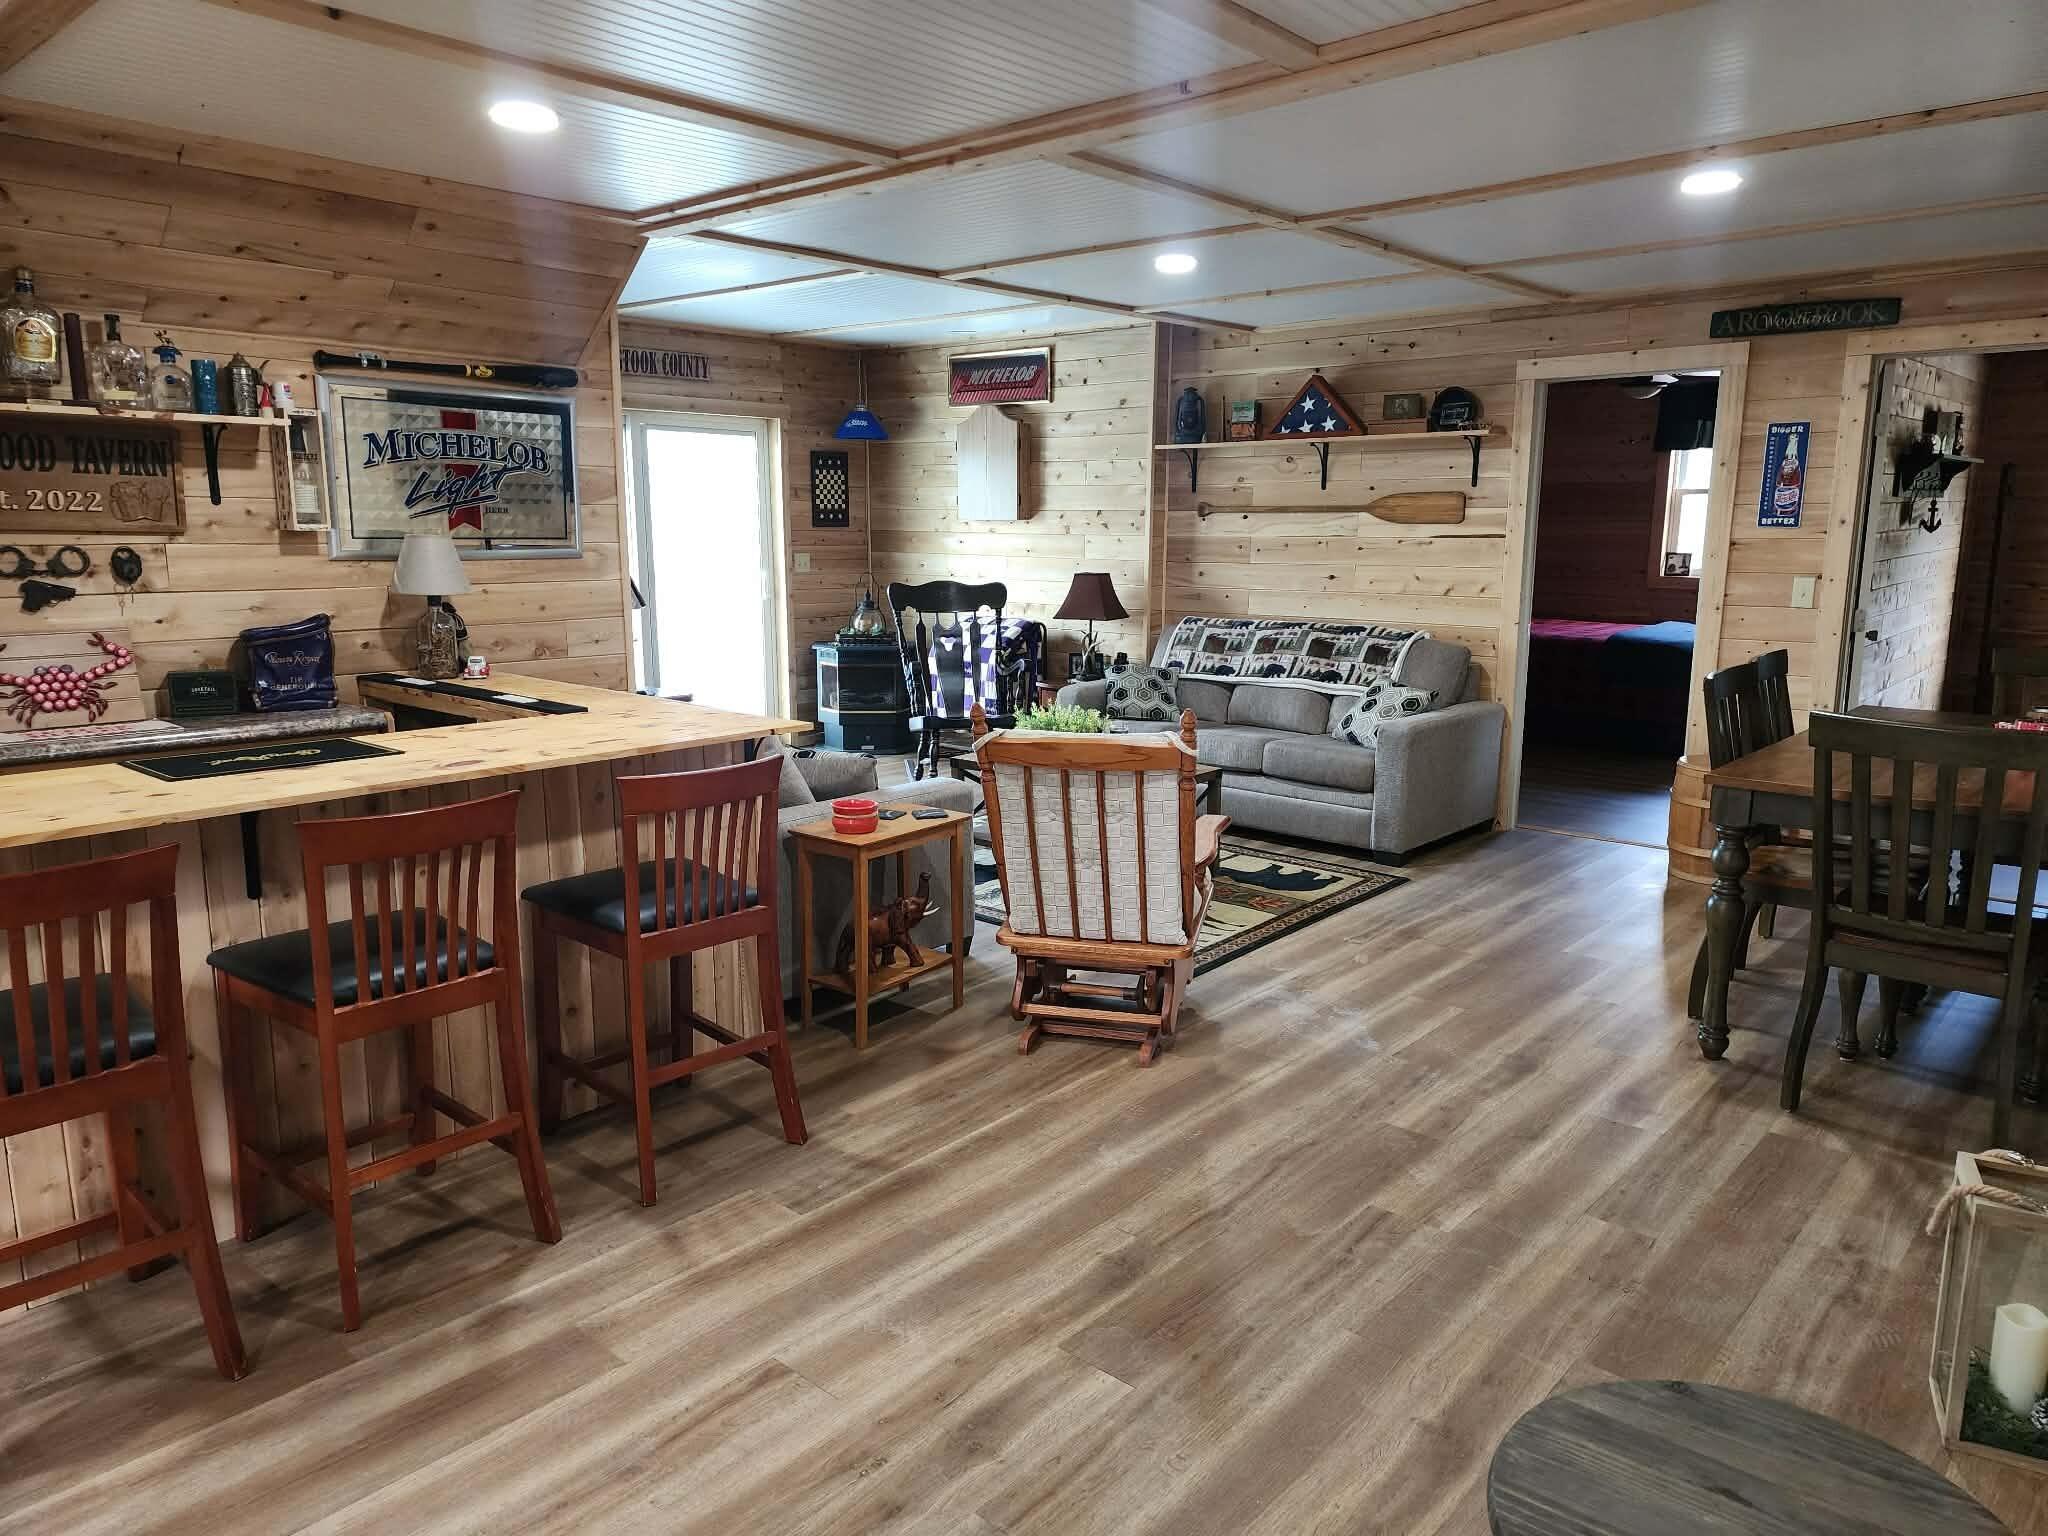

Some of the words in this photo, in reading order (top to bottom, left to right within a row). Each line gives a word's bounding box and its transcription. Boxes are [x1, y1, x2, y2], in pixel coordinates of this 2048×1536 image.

[661, 351, 709, 379] COUNTY
[967, 365, 1038, 386] MICHELOB
[1771, 425, 1804, 434] BIGGER
[66, 436, 170, 478] TAVERN
[363, 427, 551, 475] MICHELOB
[26, 489, 104, 512] 2022
[404, 463, 526, 519] Light
[1761, 517, 1796, 525] BETTER
